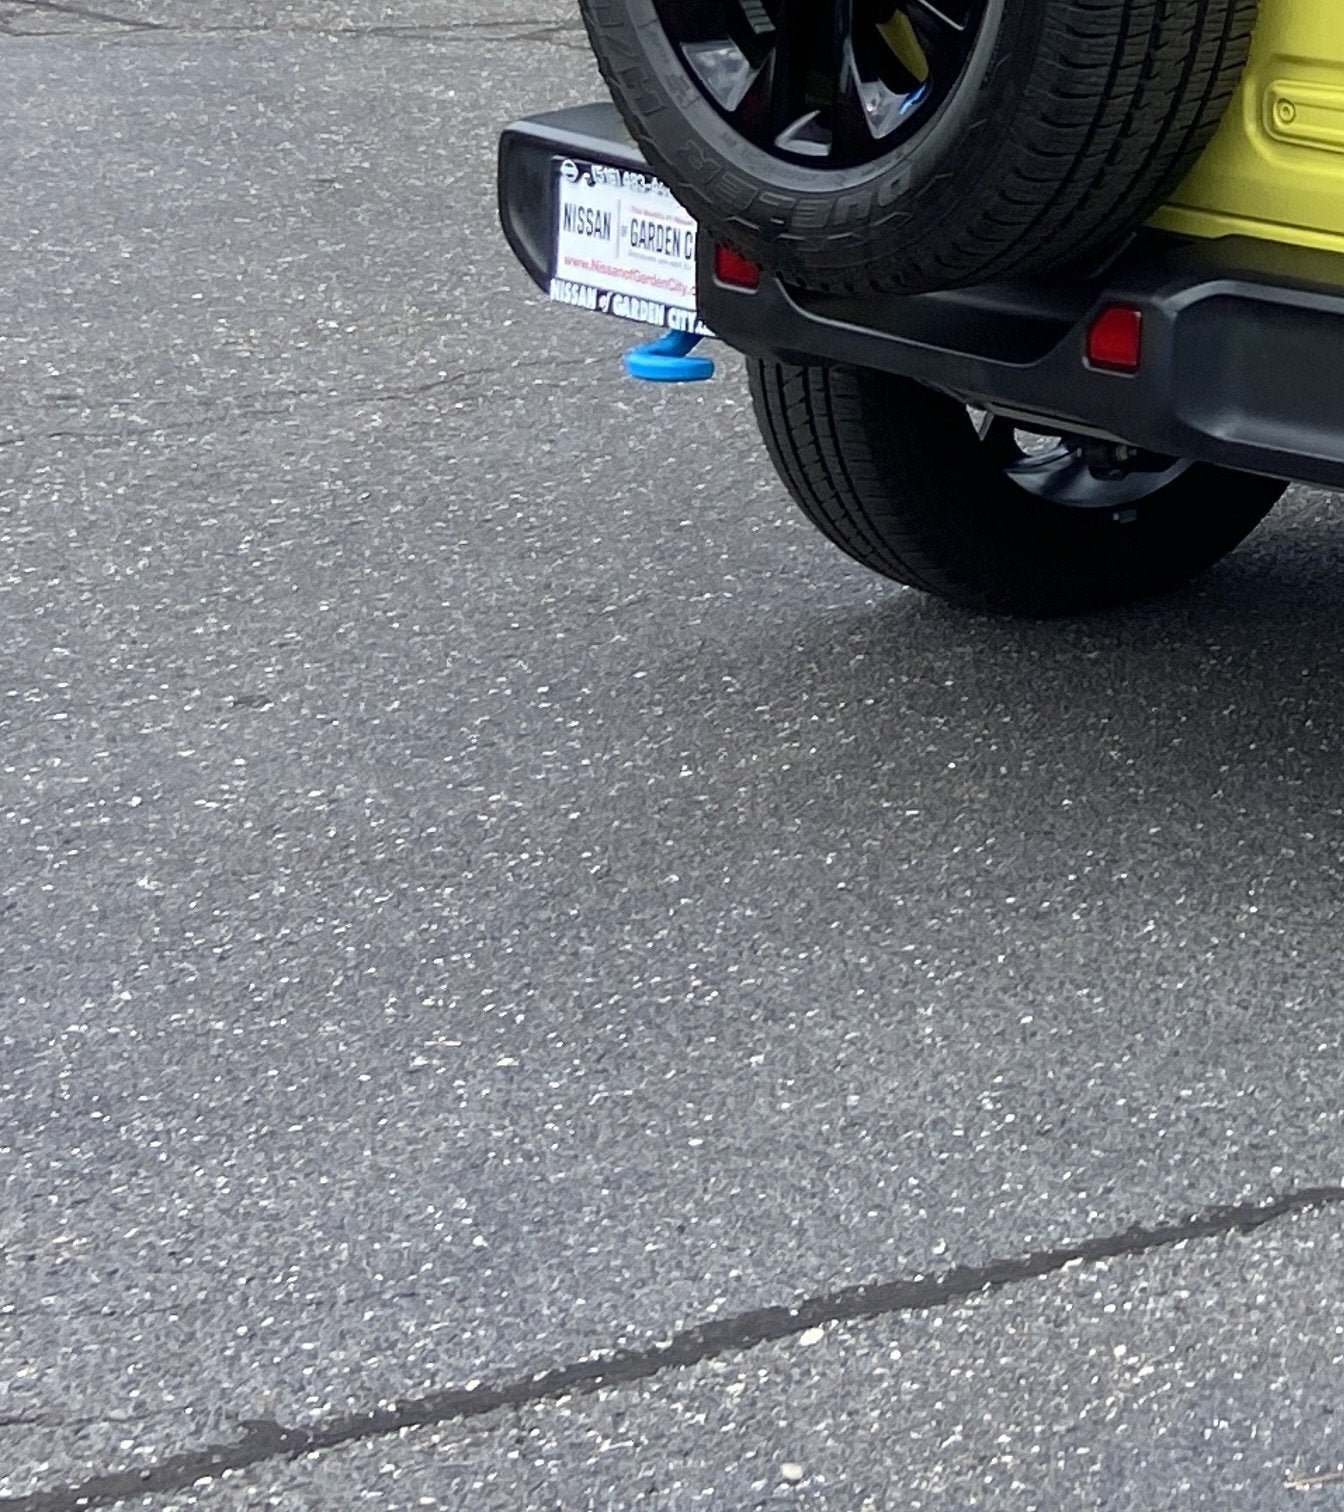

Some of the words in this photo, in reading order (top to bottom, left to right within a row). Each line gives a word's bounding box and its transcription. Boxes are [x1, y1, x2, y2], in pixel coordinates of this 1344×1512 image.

[563, 202, 612, 241] NISSAN
[630, 218, 681, 258] GARDEN
[550, 277, 598, 310] NISSAN
[612, 293, 667, 327] GARDEN
[667, 306, 698, 334] CITY
